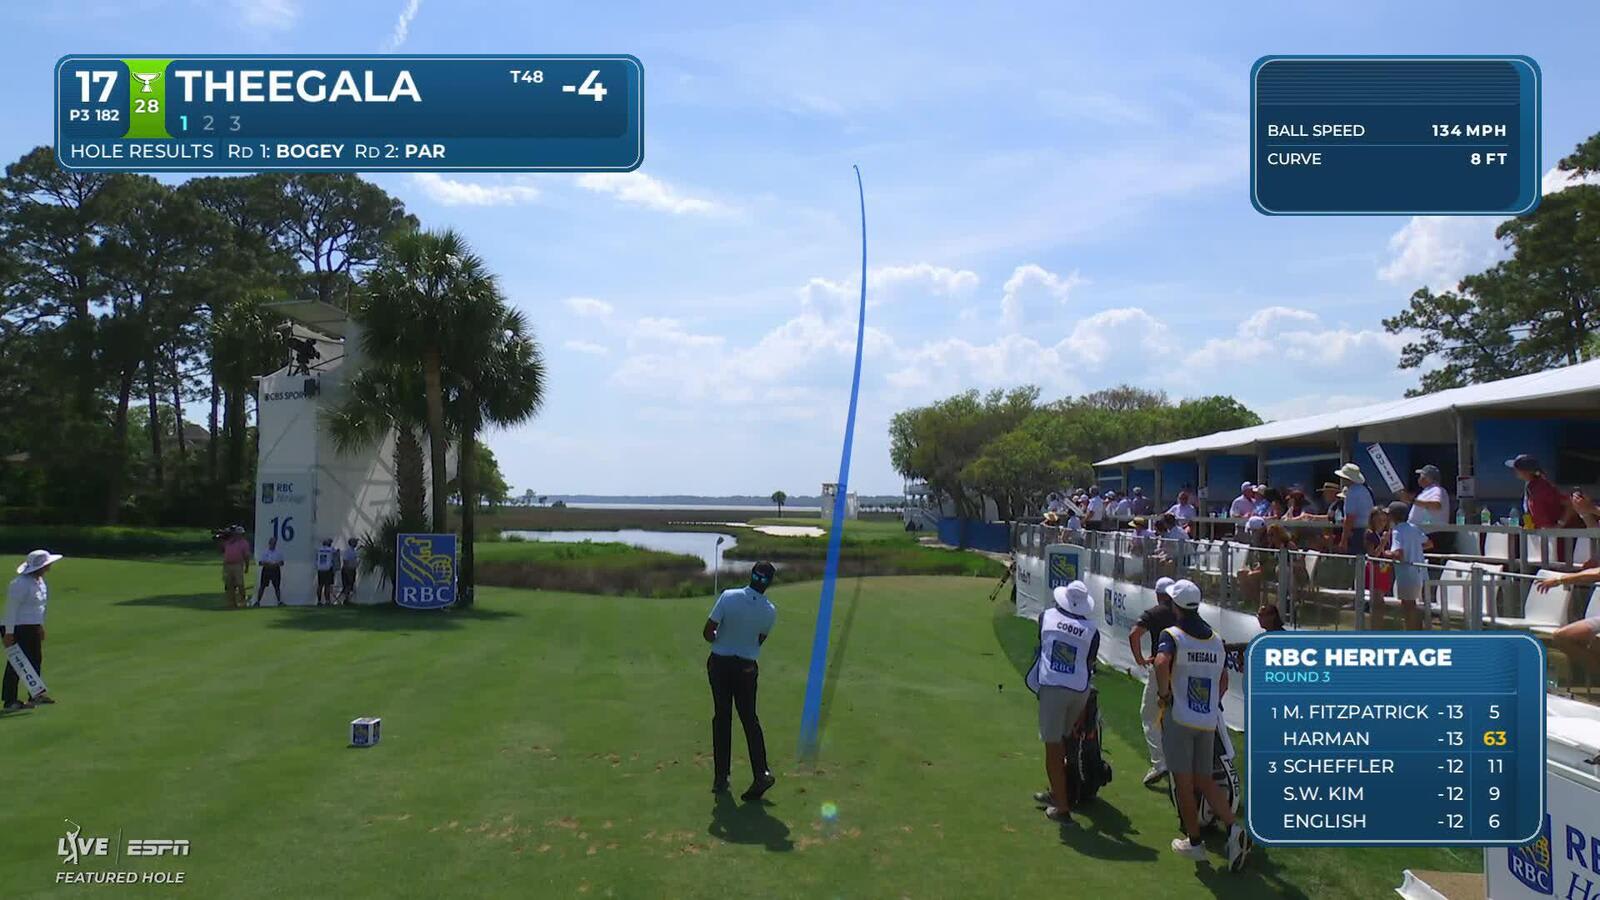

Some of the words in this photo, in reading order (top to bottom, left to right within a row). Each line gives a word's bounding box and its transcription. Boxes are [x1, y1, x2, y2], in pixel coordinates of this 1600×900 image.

[276, 483, 294, 493] RBC
[270, 516, 295, 543] 16
[402, 586, 451, 603] RBC
[1113, 591, 1127, 611] RBC
[1056, 621, 1086, 637] COODY
[1512, 855, 1549, 891] RBC
